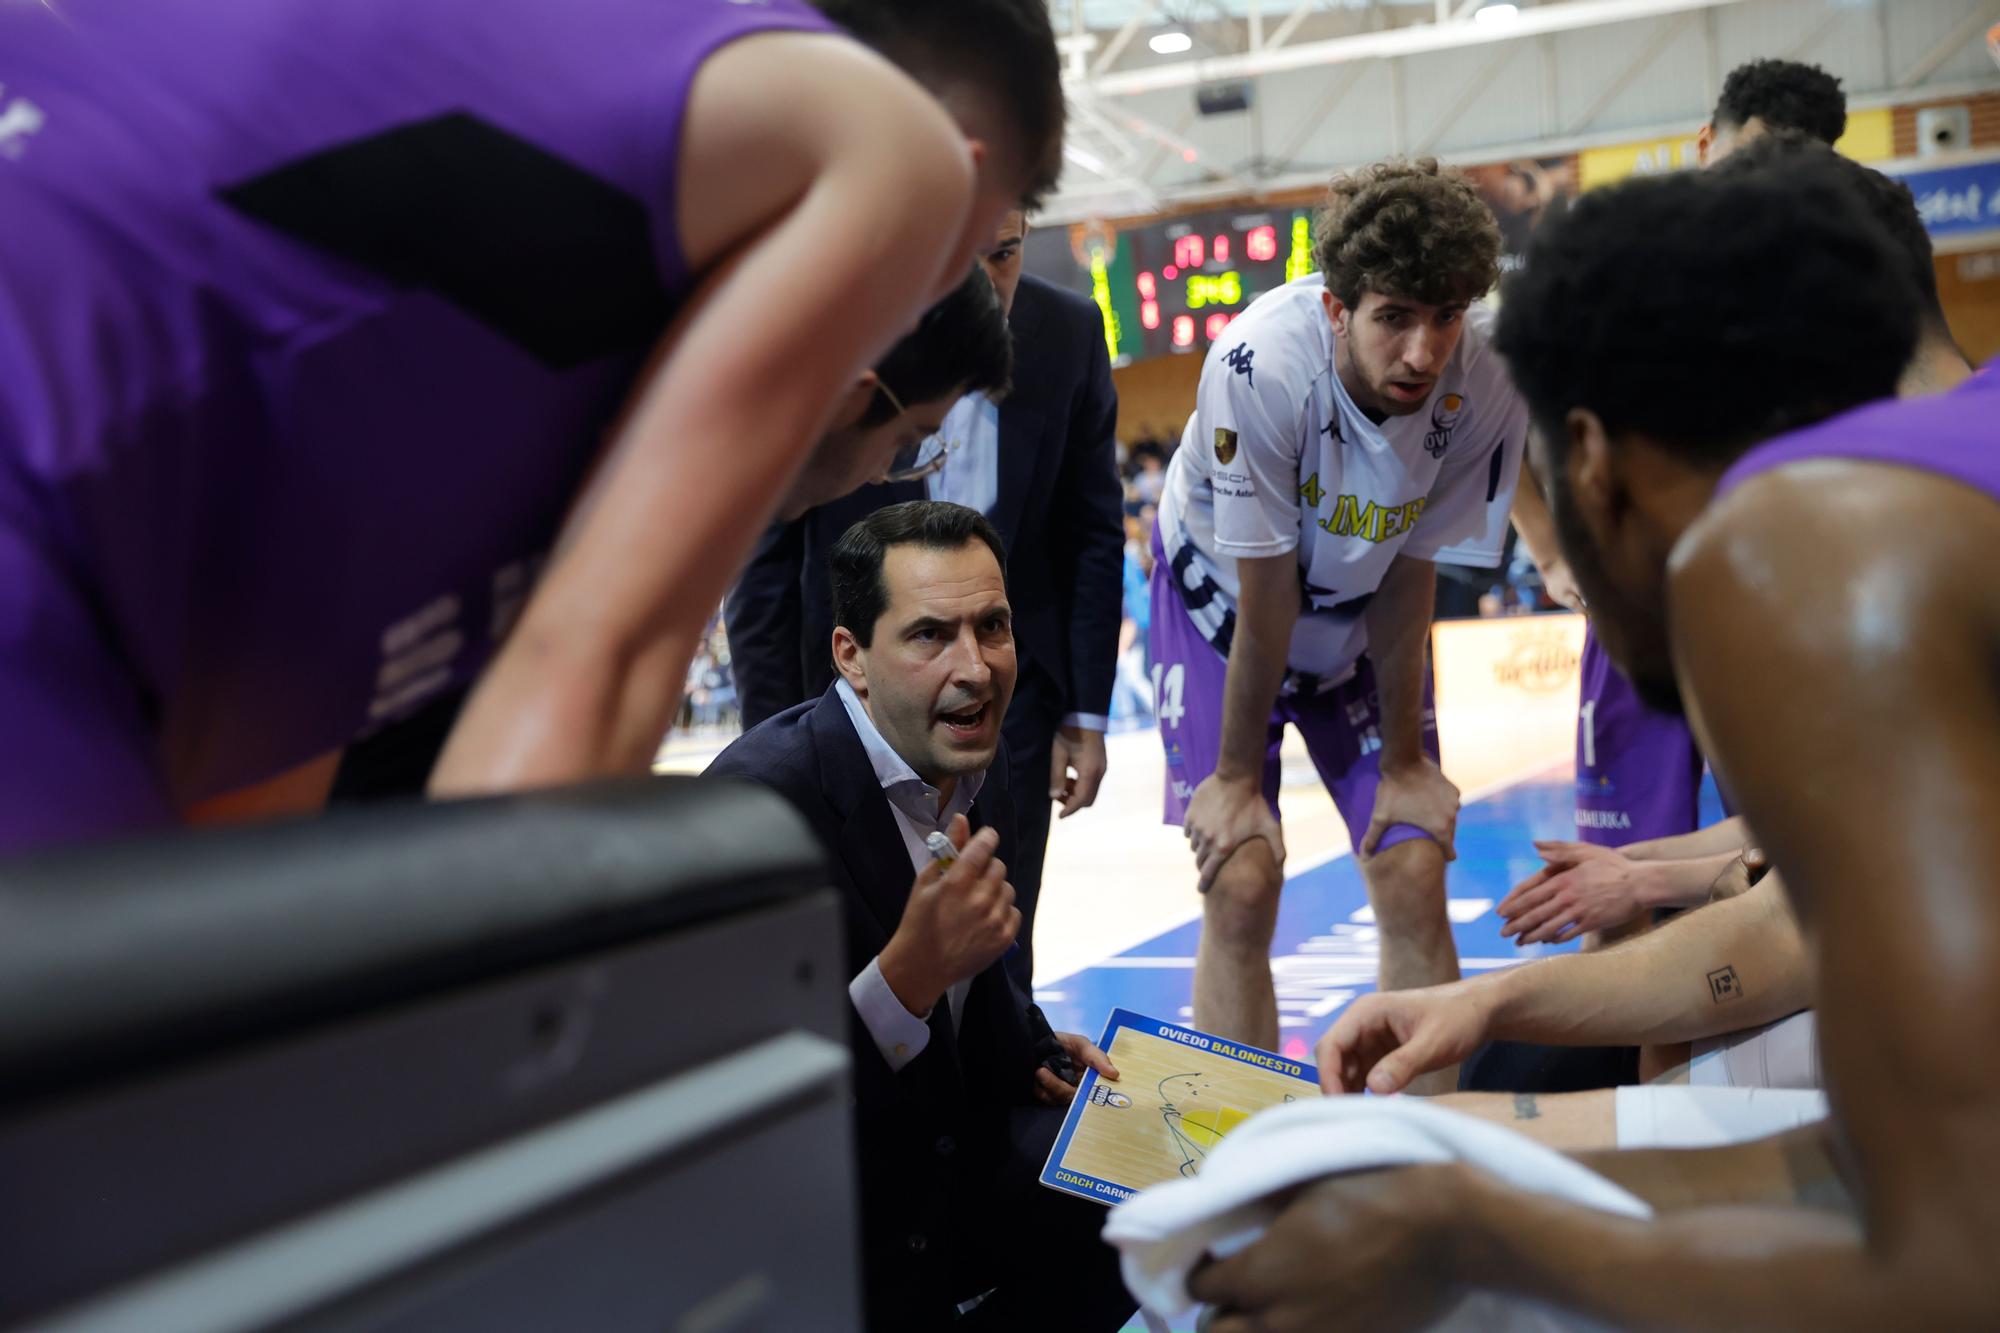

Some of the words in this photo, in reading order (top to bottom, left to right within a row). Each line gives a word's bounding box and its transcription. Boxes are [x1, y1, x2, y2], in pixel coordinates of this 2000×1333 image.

[1158, 1026, 1209, 1049] OVIEDO
[1211, 1042, 1301, 1076] BALONCESTO
[1055, 1170, 1094, 1189] COACH
